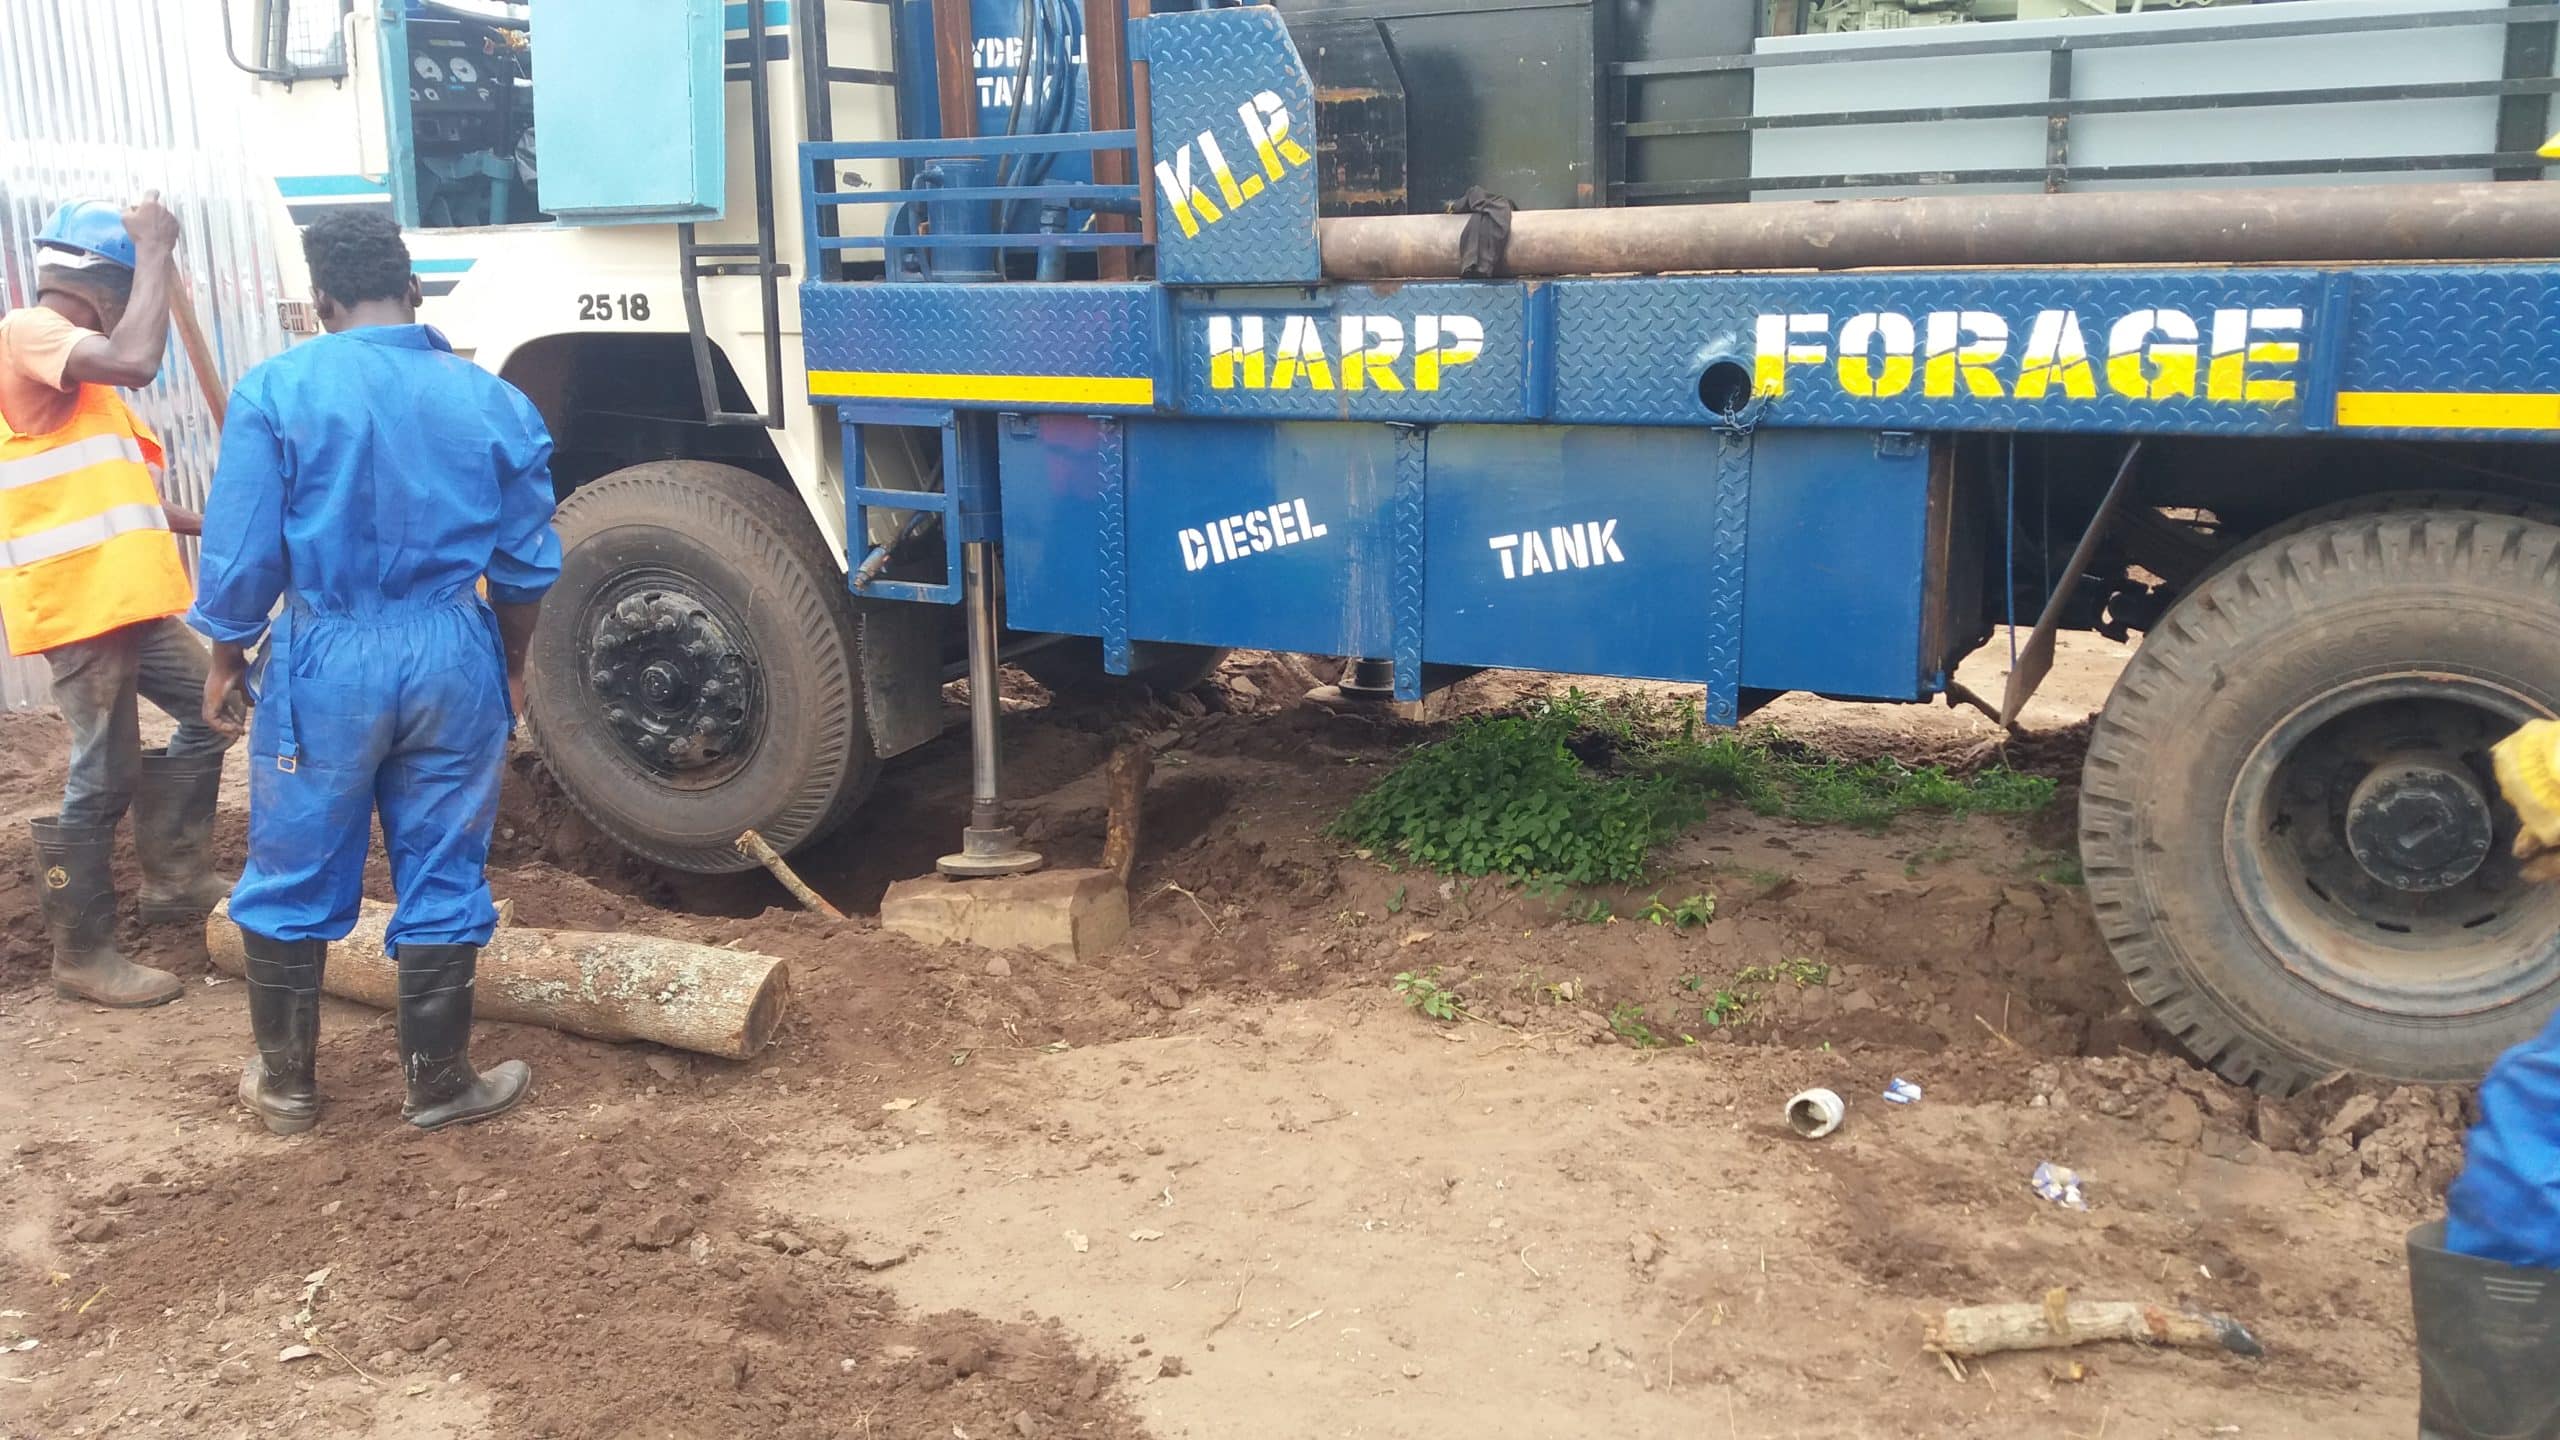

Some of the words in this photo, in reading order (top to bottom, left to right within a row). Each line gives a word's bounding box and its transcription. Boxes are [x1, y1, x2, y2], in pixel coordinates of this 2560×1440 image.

[1154, 90, 1311, 239] KLR
[577, 293, 650, 321] 2518
[1208, 314, 1485, 392] HARP
[1754, 307, 2304, 401] FORAGE
[1178, 497, 1328, 572] DIESEL
[1488, 518, 1625, 579] TANK
